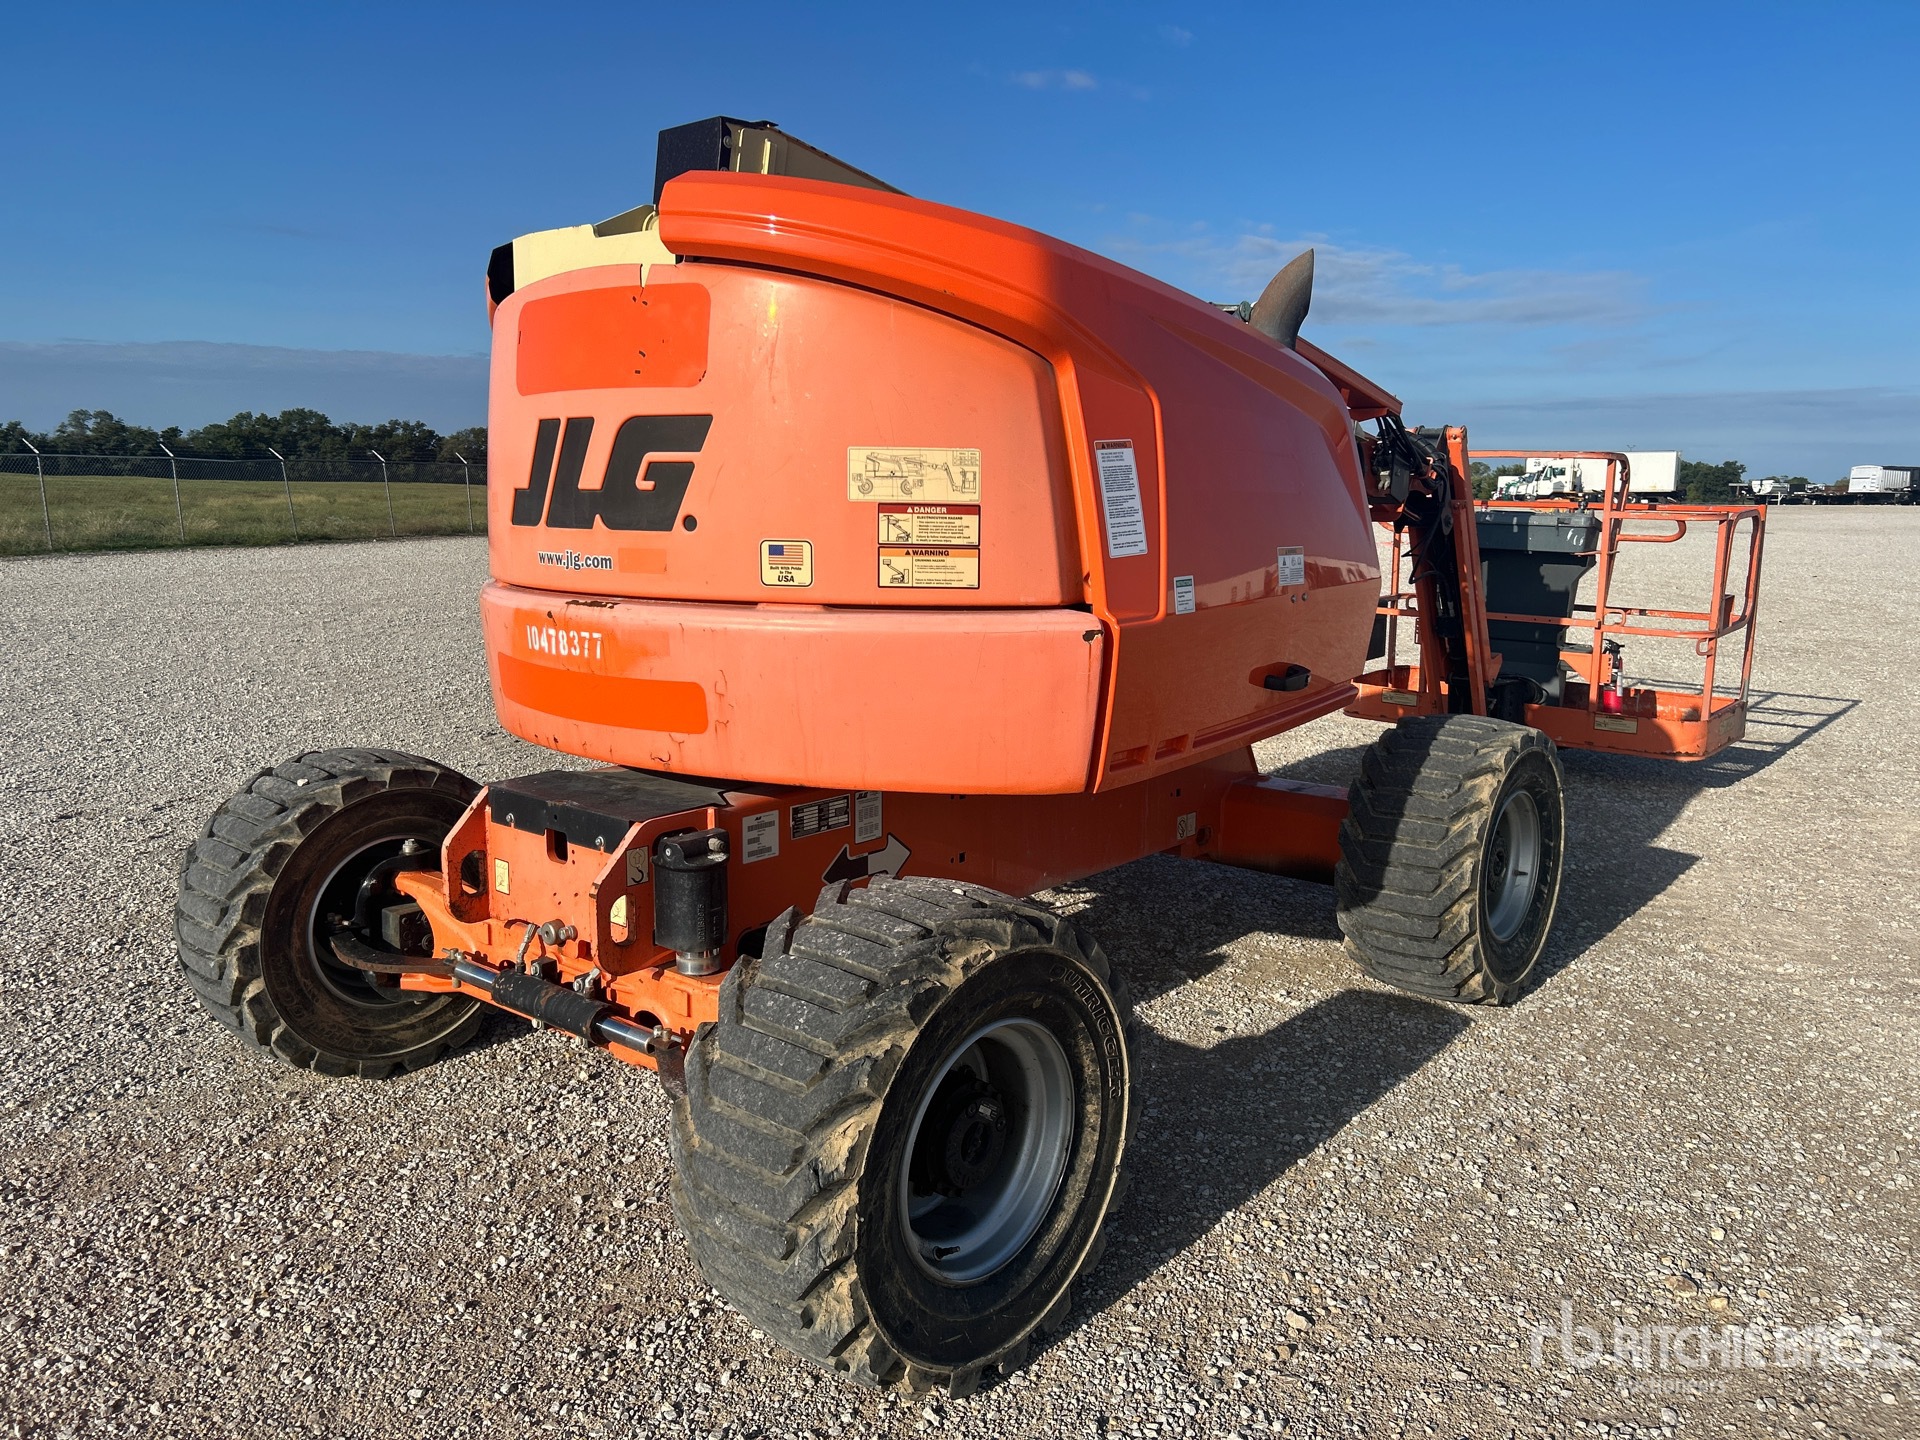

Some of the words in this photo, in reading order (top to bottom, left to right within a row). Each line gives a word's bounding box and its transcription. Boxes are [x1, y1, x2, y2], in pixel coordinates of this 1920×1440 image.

[913, 506, 947, 514] DANGER
[912, 549, 950, 557] WARNING
[538, 550, 613, 571] www.jlg.com
[777, 575, 795, 583] USA
[526, 625, 602, 660] 10478377
[1049, 963, 1121, 1099] OUTRIGGER
